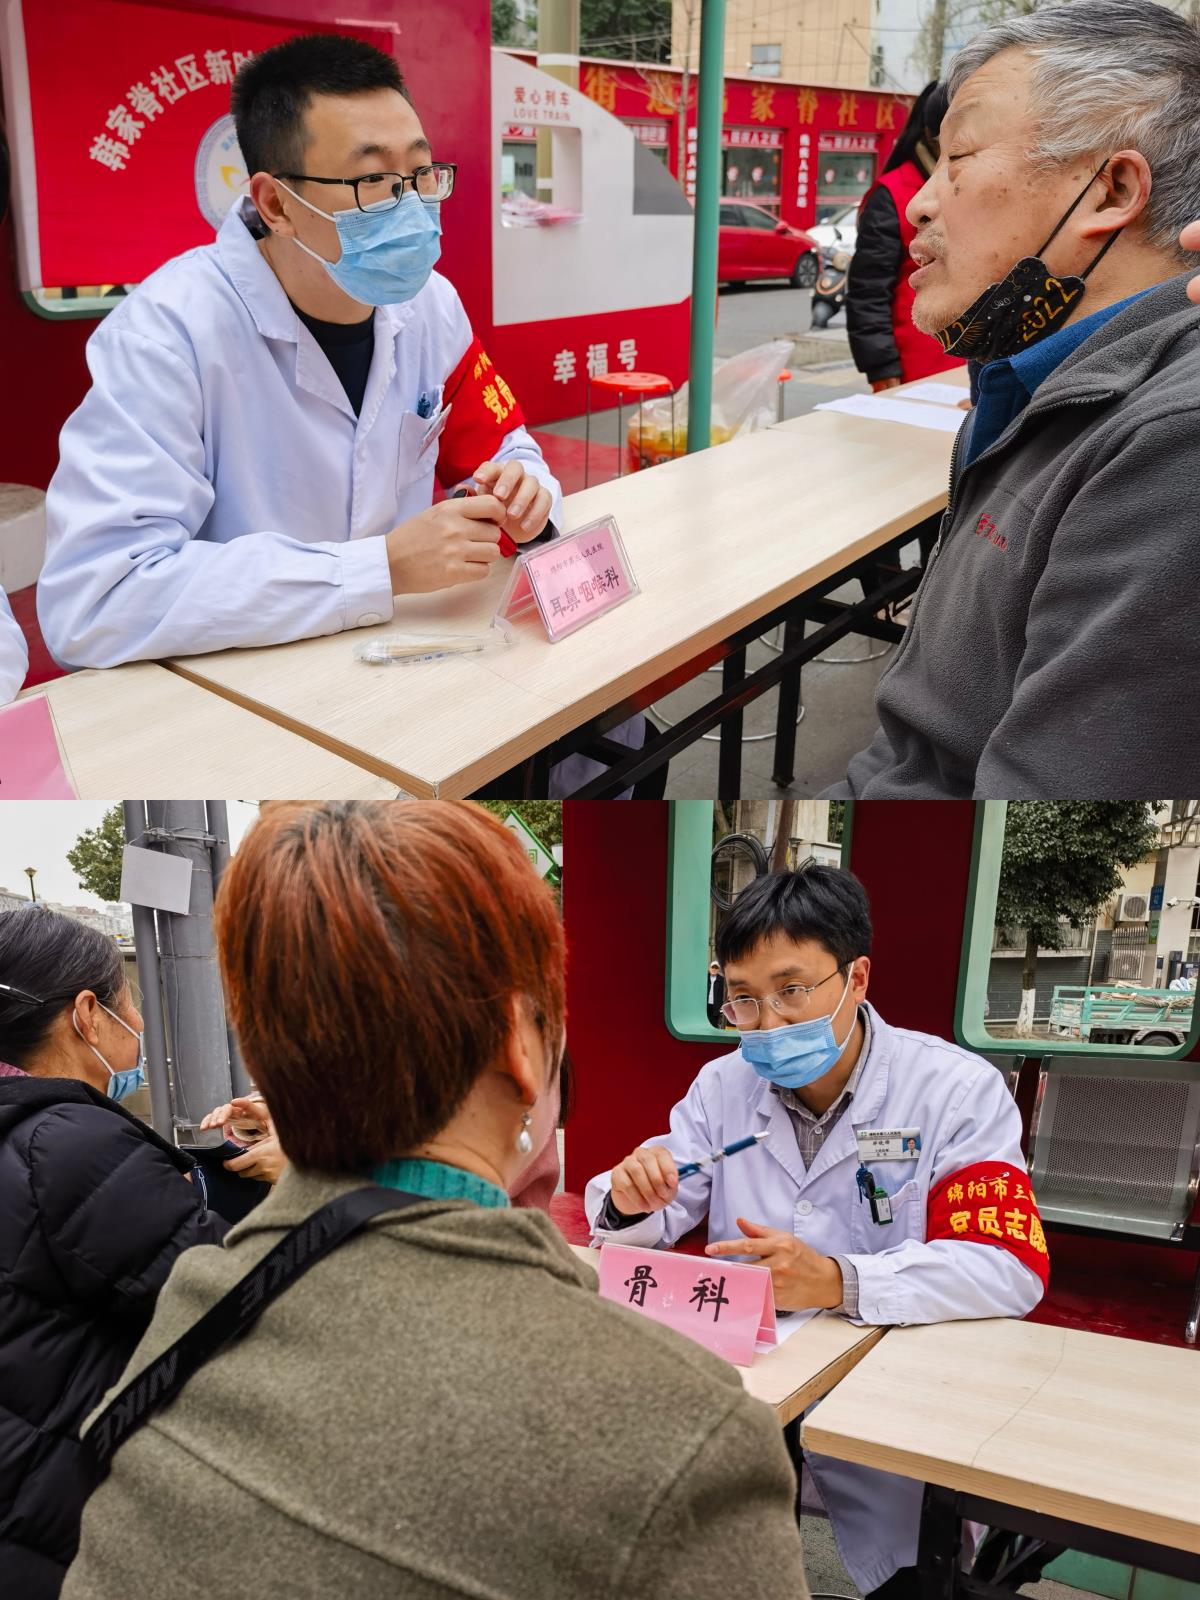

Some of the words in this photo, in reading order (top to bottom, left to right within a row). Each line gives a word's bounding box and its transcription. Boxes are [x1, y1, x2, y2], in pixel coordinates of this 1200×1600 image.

[513, 86, 571, 107] 爱心列车
[514, 109, 539, 120] LOVE
[543, 110, 571, 122] TRAIN
[1017, 276, 1080, 342] 2022
[553, 338, 639, 385] 幸福号
[482, 374, 517, 425] 党员
[550, 566, 620, 615] 耳鼻咽喉科
[947, 1179, 1038, 1208] 绵阳市三
[624, 1264, 730, 1323] 骨科
[94, 1350, 179, 1462] NIKE
